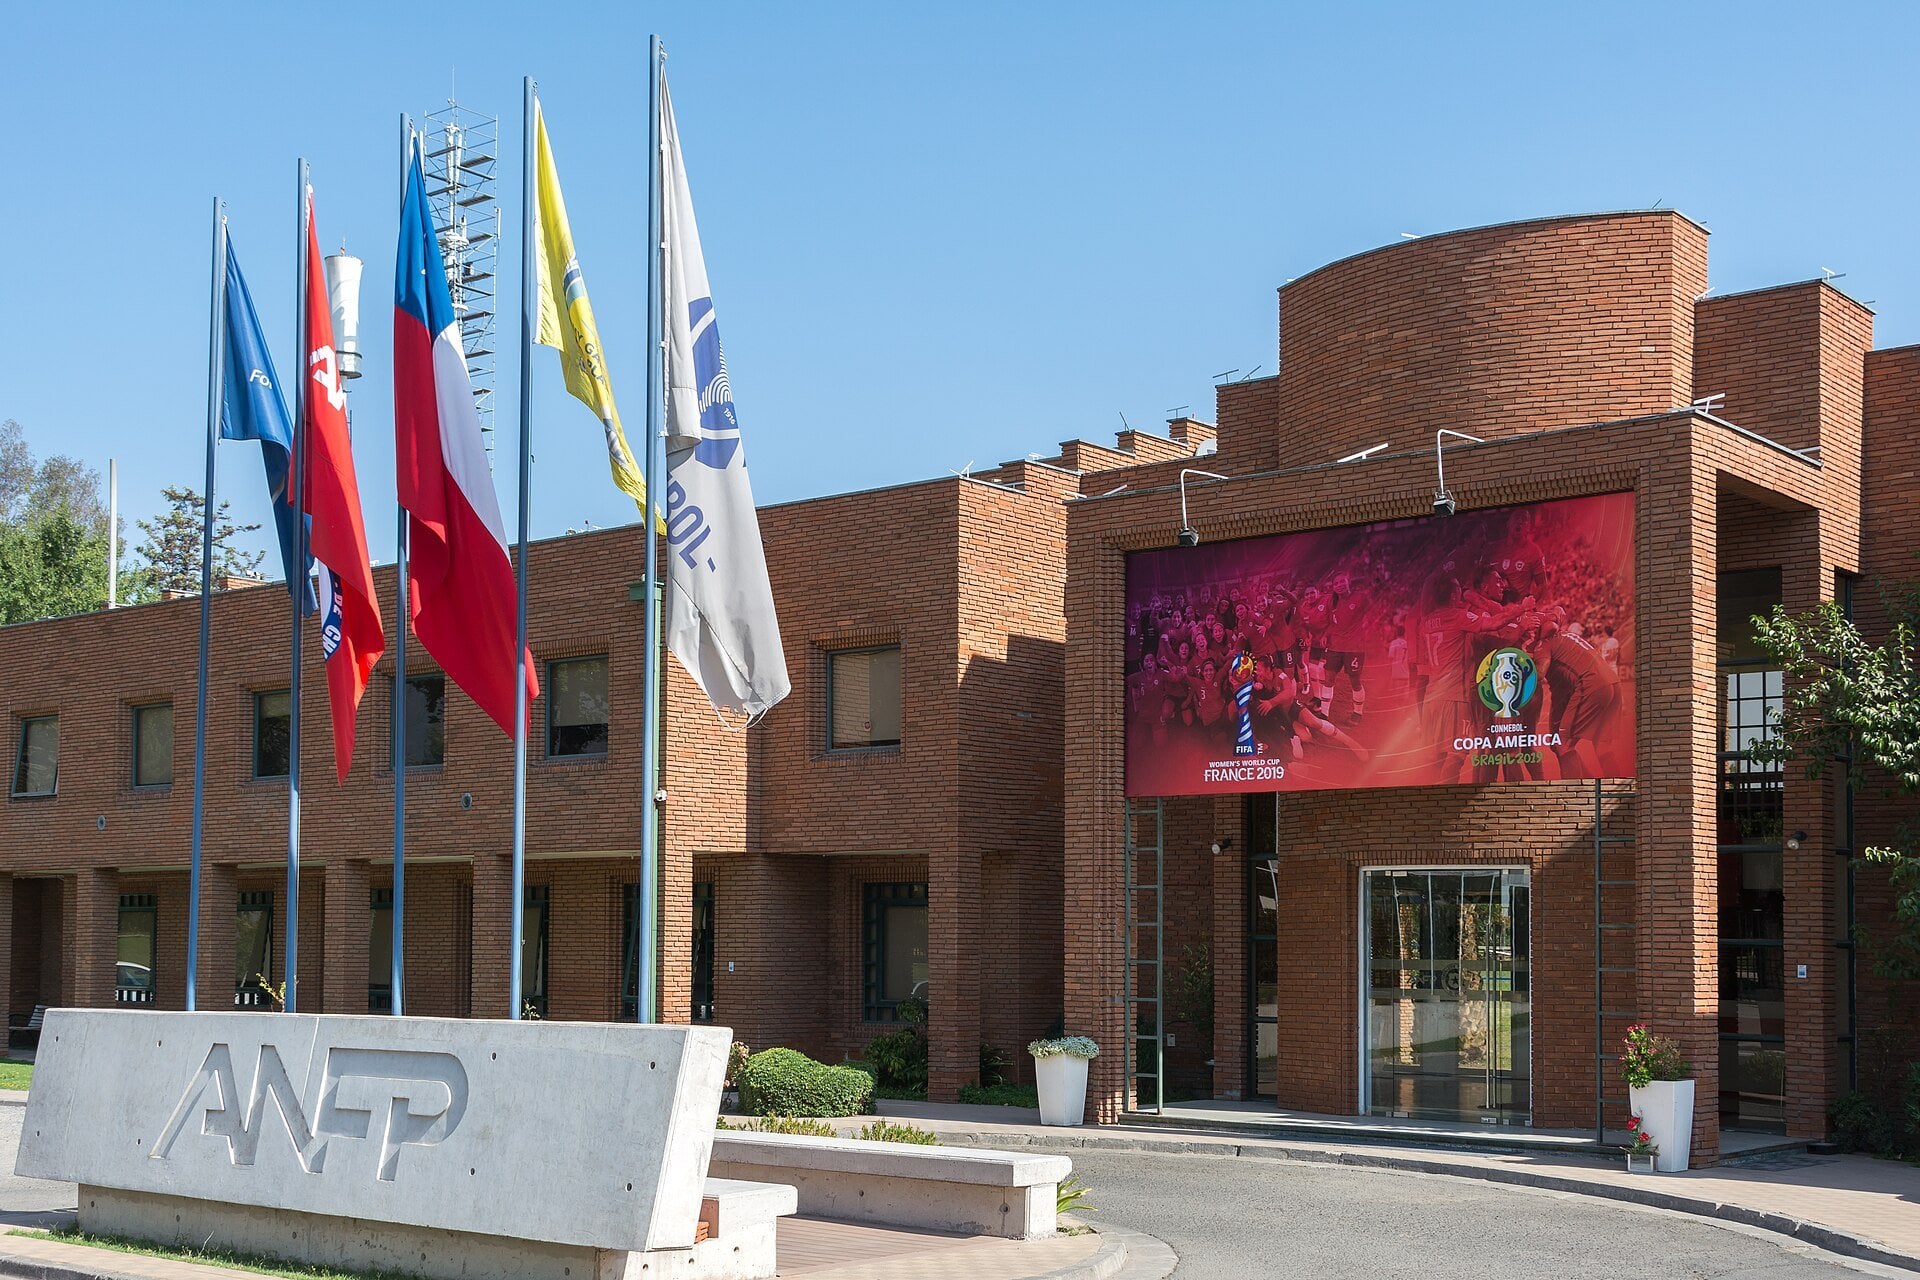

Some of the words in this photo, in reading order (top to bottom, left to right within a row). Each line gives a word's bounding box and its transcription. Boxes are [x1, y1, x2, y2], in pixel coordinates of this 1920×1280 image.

[724, 407, 736, 425] 1916
[667, 472, 711, 570] BOL
[1287, 652, 1293, 662] 8
[1236, 745, 1253, 754] FIFA
[1453, 736, 1492, 750] COPA
[1494, 733, 1562, 749] AMERICA
[1208, 760, 1240, 769] WOMEN'S
[1241, 758, 1266, 767] WORLD
[1266, 758, 1281, 766] CUP
[1514, 751, 1543, 764] 2019
[1203, 767, 1255, 783] FRANCE
[1256, 766, 1285, 780] 2019
[150, 1043, 469, 1182] ANFP
